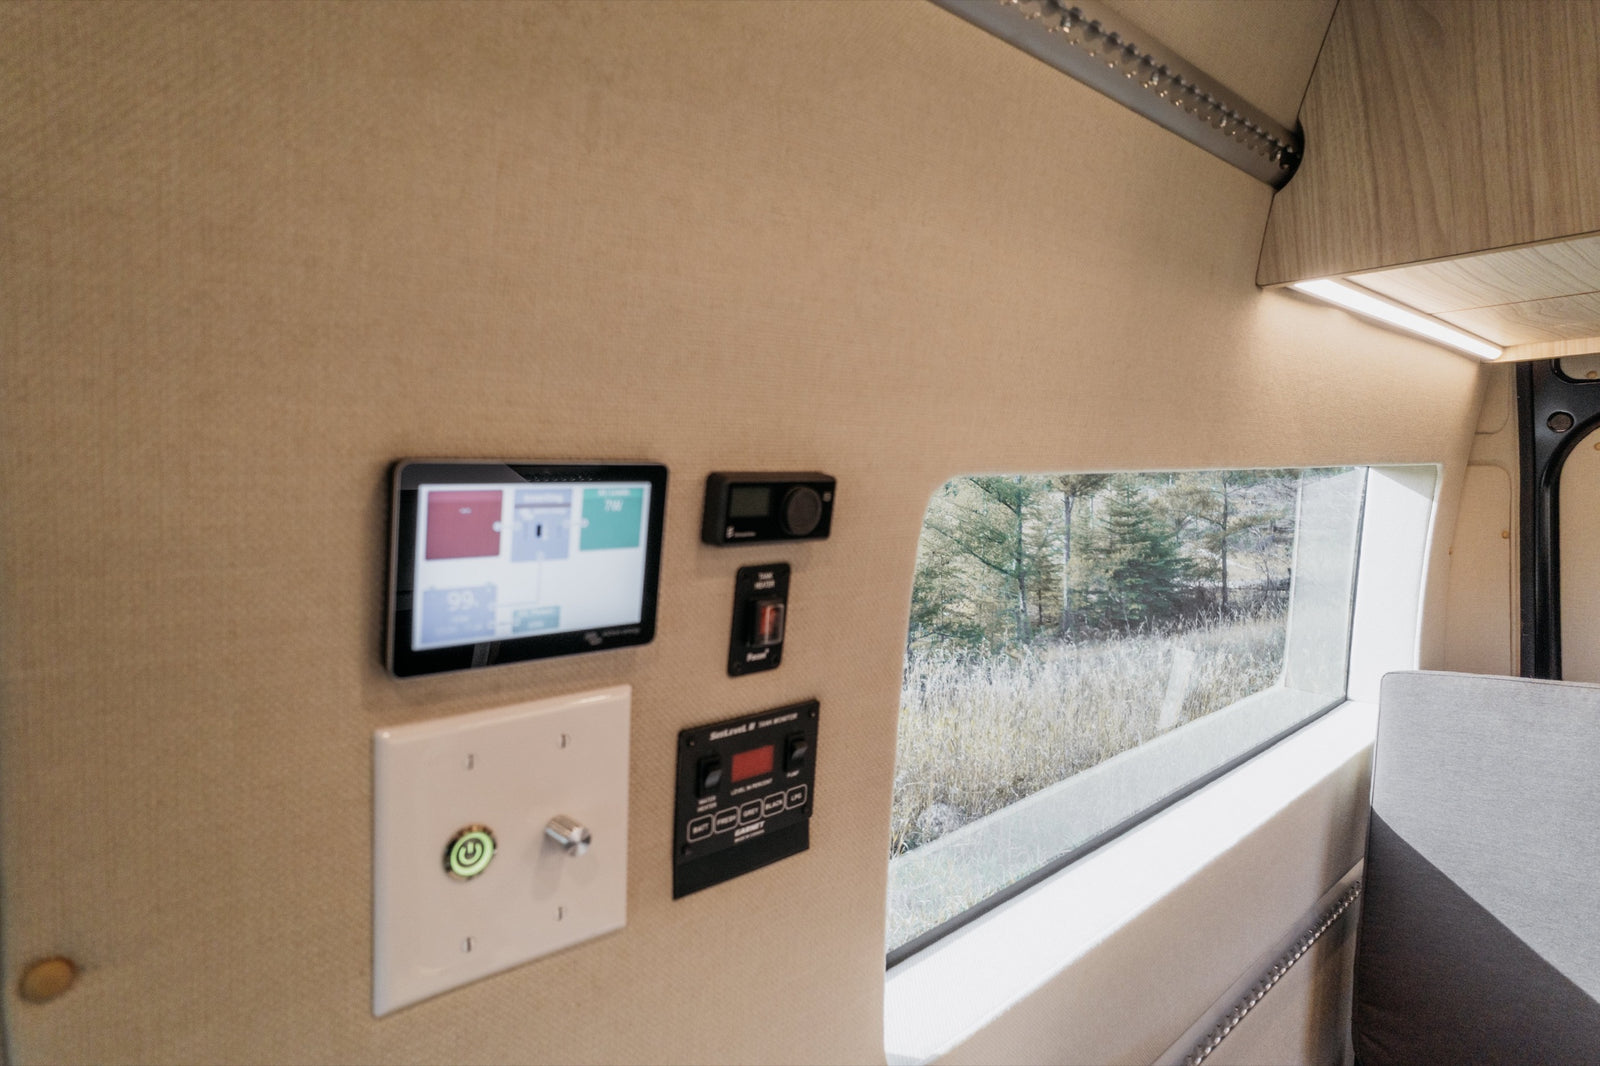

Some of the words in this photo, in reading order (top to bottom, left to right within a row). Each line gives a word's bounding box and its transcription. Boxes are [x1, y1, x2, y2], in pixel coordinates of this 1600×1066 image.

[692, 822, 710, 834] BATT
[716, 815, 737, 826] FRESH
[765, 799, 783, 811] BLACK
